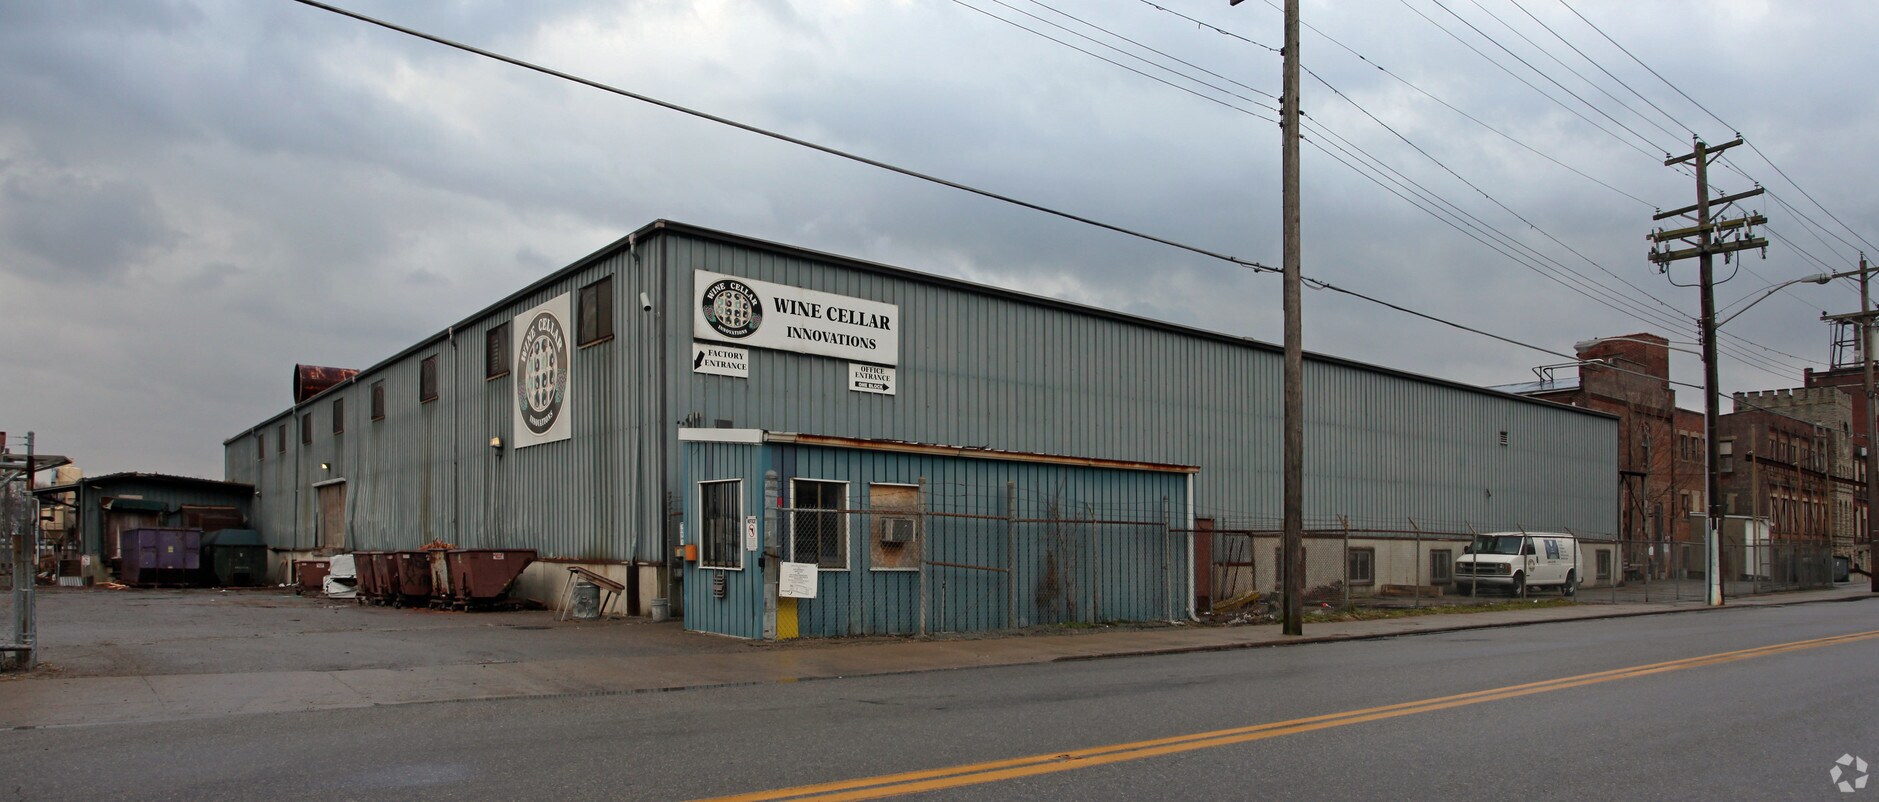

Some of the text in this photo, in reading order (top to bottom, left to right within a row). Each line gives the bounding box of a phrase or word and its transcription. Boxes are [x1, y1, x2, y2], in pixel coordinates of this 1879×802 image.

[707, 282, 757, 306] WINE CELLAR
[773, 297, 890, 330] WINE CELLAR
[718, 325, 747, 335] INNOVATIONS
[521, 318, 562, 362] WINE CELLAR
[787, 326, 876, 350] INNOVATIONS
[708, 350, 744, 359] FACTORY
[705, 360, 747, 370] ENTRANCE
[860, 366, 884, 374] OFFICE
[855, 372, 890, 381] ENTRANCE
[530, 410, 553, 427] INNOVATIONS
